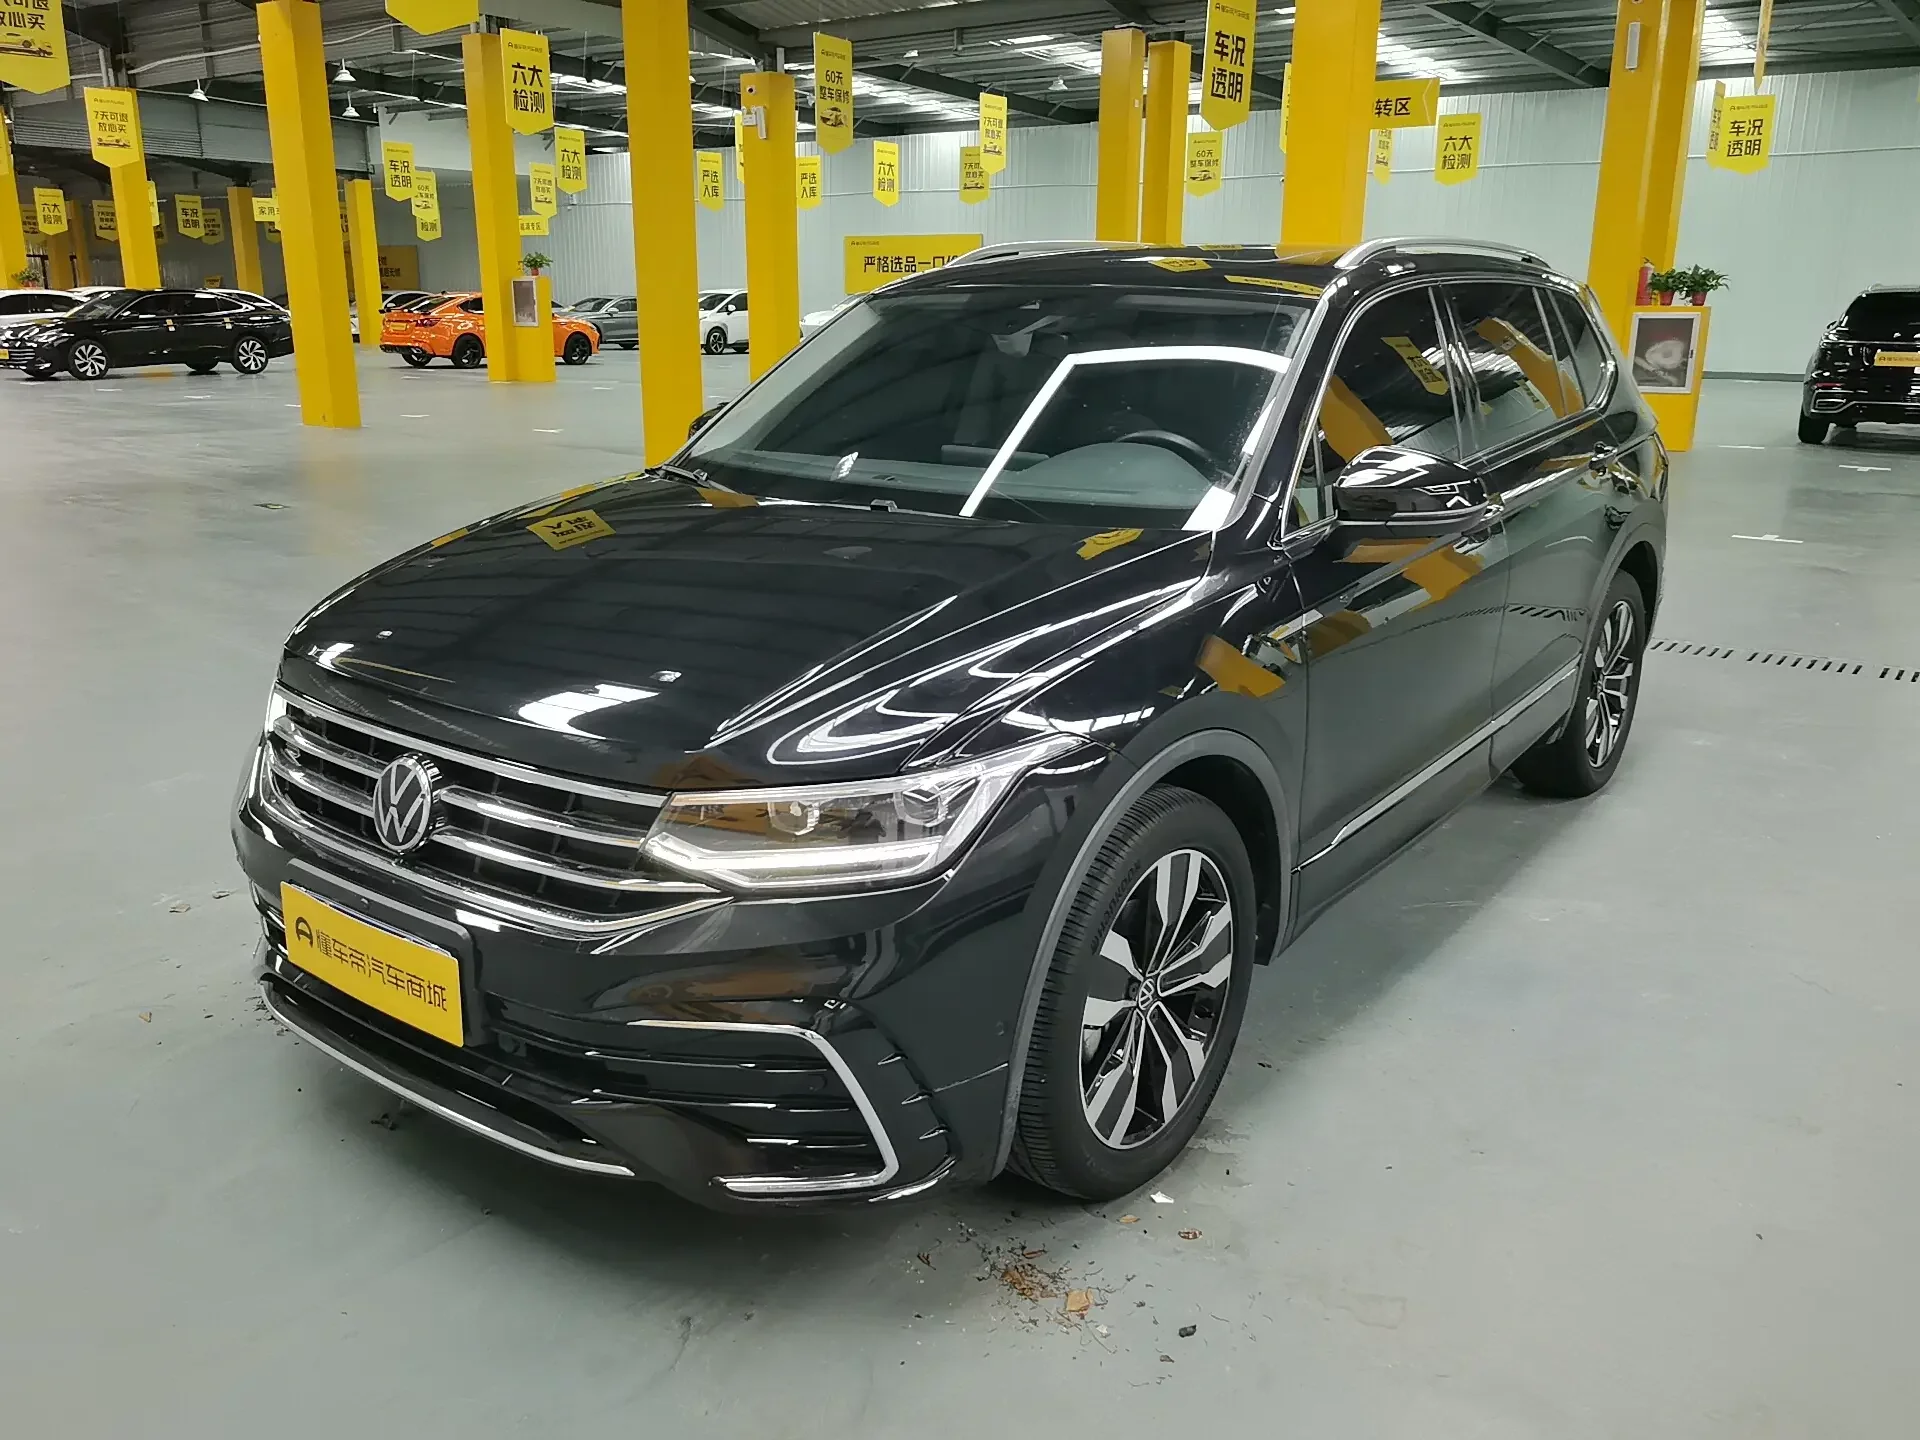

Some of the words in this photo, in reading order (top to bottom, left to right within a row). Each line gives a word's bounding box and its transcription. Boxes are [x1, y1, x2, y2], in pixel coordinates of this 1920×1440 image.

[1213, 30, 1246, 67] 车况
[512, 62, 543, 87] 六大
[825, 69, 843, 86] 60天
[1210, 67, 1244, 103] 透明
[513, 88, 545, 113] 检测
[819, 85, 850, 104] 整车保修
[93, 110, 128, 122] 7天可退
[98, 122, 127, 134] 放心买
[1729, 119, 1764, 136] 车况
[1443, 135, 1473, 152] 六大
[1726, 139, 1762, 157] 透明
[561, 148, 580, 164] 六大
[1196, 149, 1213, 158] 60天
[389, 160, 411, 173] 车况
[878, 161, 895, 176] 六大
[963, 162, 984, 171] 7天可
[1441, 153, 1471, 170] 检测
[561, 165, 582, 180] 检测
[702, 169, 719, 183] 严选
[800, 172, 817, 185] 严选
[390, 174, 412, 188] 透明
[878, 177, 895, 192] 检测
[703, 184, 719, 198] 入库
[801, 186, 818, 198] 入库
[41, 203, 61, 213] 六大
[181, 208, 199, 218] 车况
[182, 219, 200, 229] 透明
[315, 928, 448, 1012] 懂车帝汽车商城
